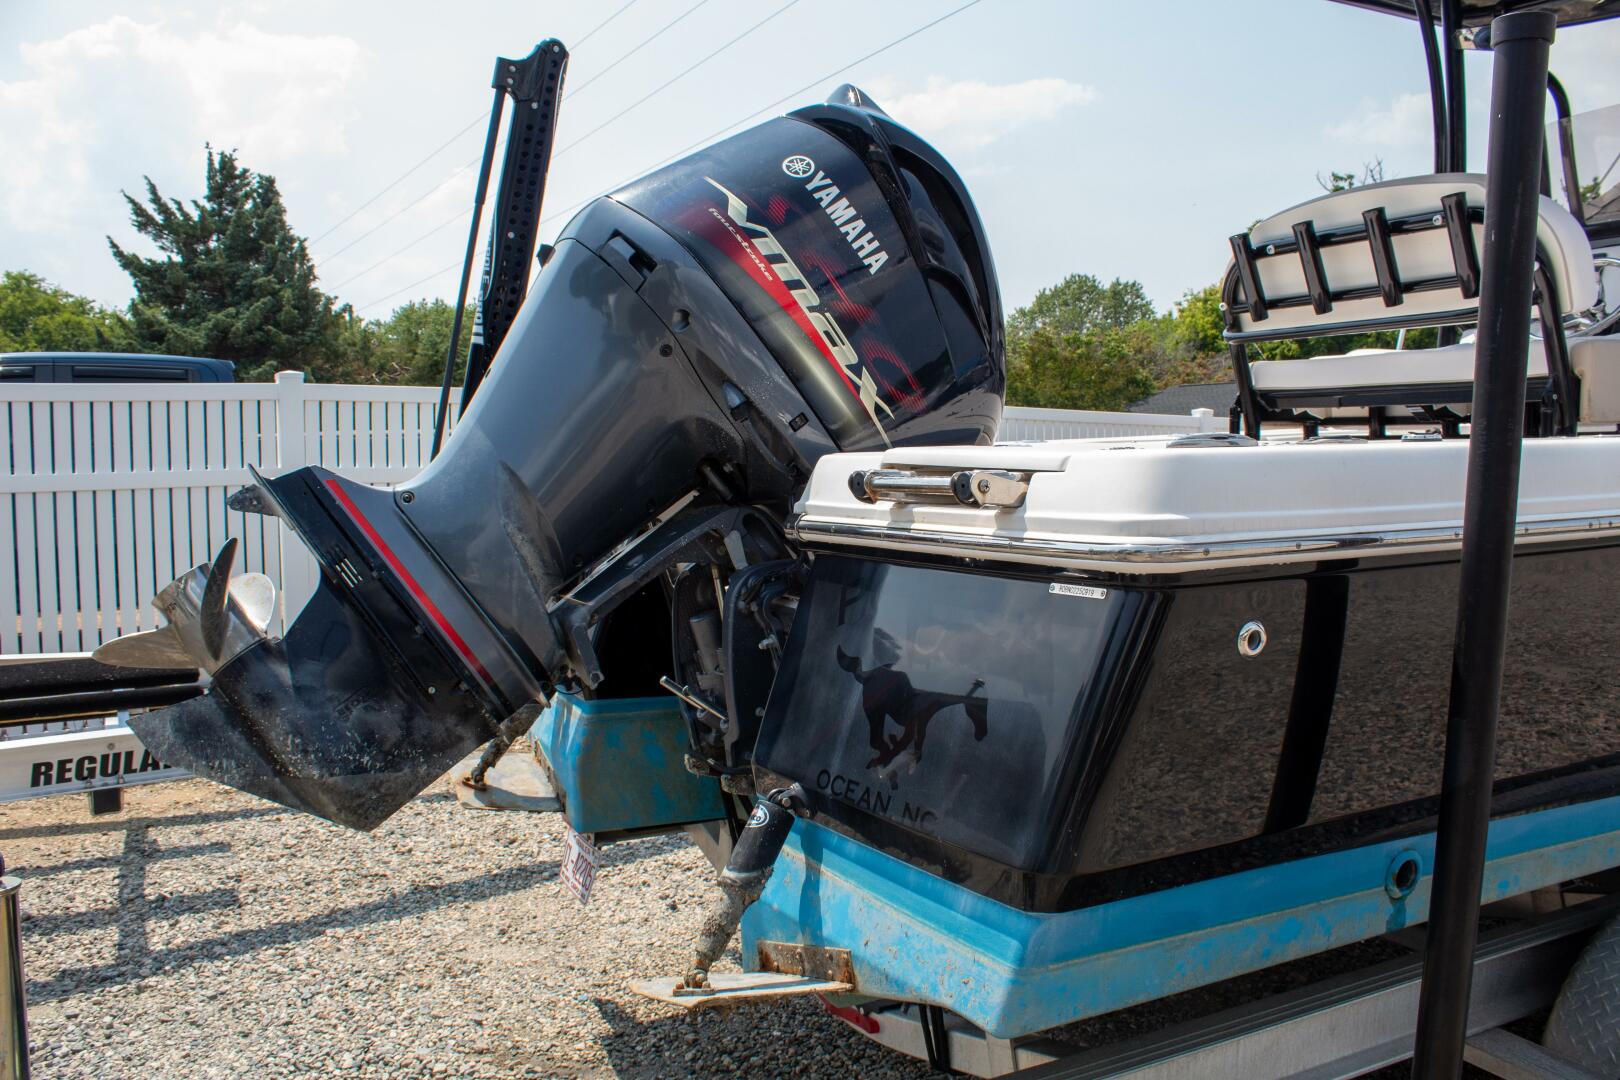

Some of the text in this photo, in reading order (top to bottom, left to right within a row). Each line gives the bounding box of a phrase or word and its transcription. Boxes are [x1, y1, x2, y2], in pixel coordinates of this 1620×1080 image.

[804, 169, 889, 275] YAMAHA
[30, 748, 172, 788] REGULA
[816, 768, 892, 814] OCEAN
